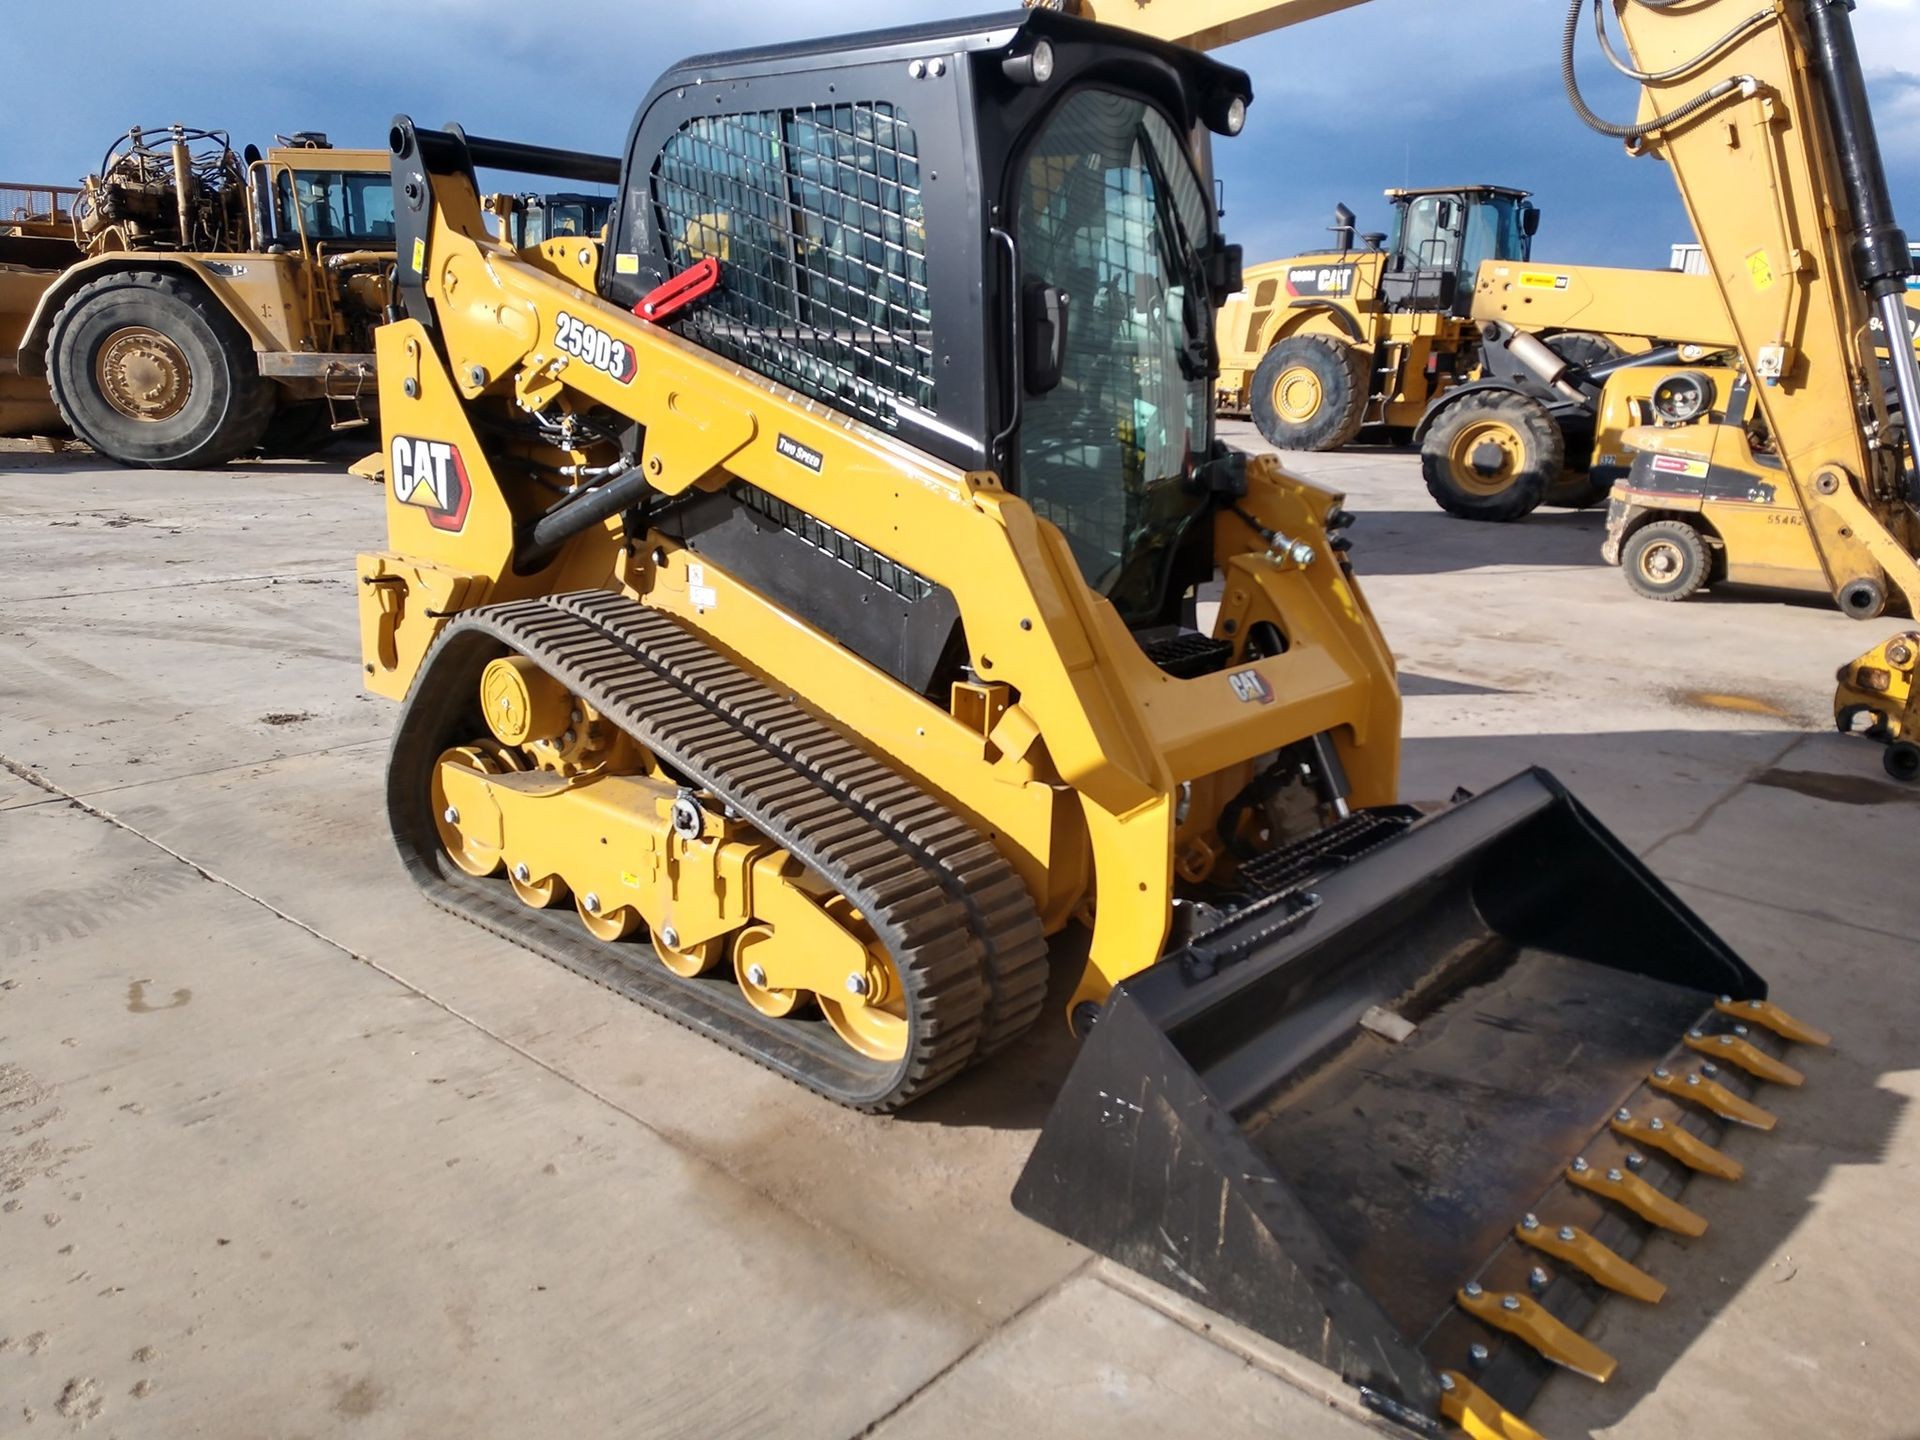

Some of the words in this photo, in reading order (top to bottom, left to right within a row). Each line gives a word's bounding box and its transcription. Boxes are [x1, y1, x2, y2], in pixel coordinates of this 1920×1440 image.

[1317, 268, 1352, 292] CAT
[555, 311, 626, 378] 259D3
[391, 436, 451, 510] CAT
[1229, 670, 1266, 701] CAT
